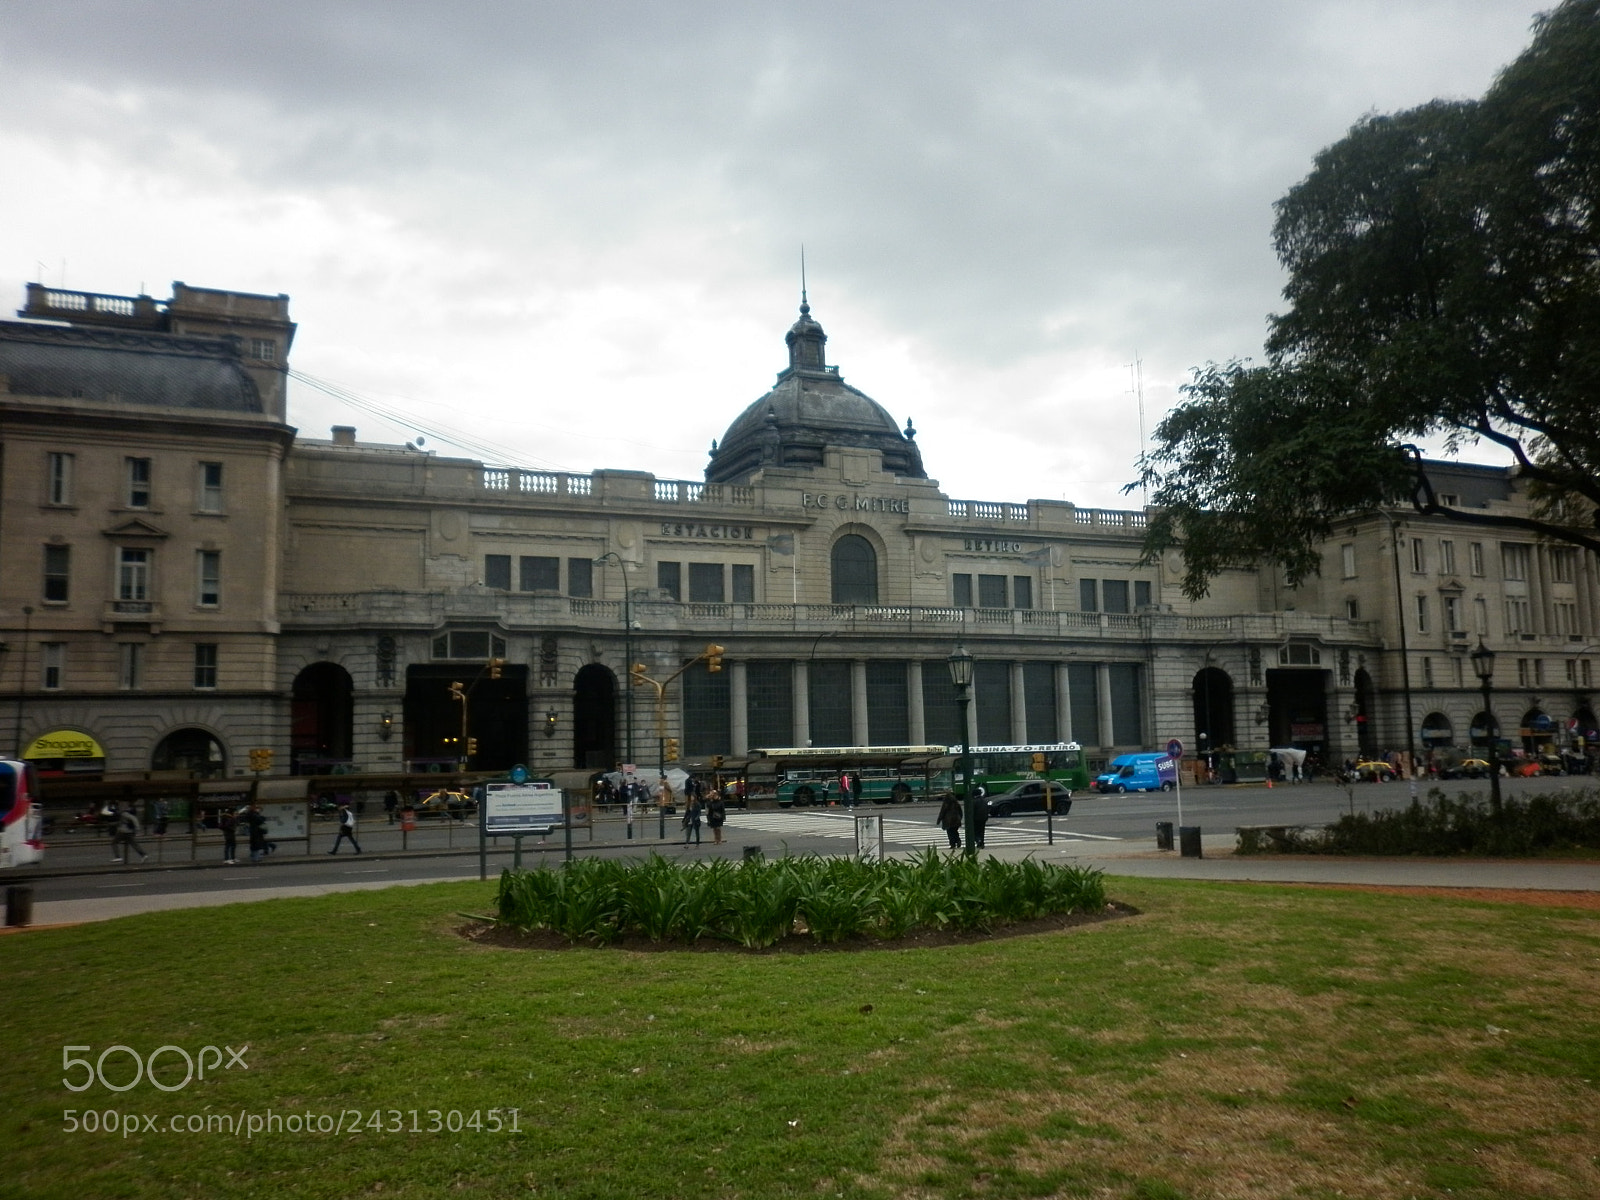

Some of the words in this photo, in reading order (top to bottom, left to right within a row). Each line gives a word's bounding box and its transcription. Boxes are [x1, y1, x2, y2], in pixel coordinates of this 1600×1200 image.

[661, 522, 753, 540] ESTACION
[964, 539, 1021, 552] RETIRO
[36, 739, 94, 751] Shopping
[1158, 760, 1174, 771] SUBE
